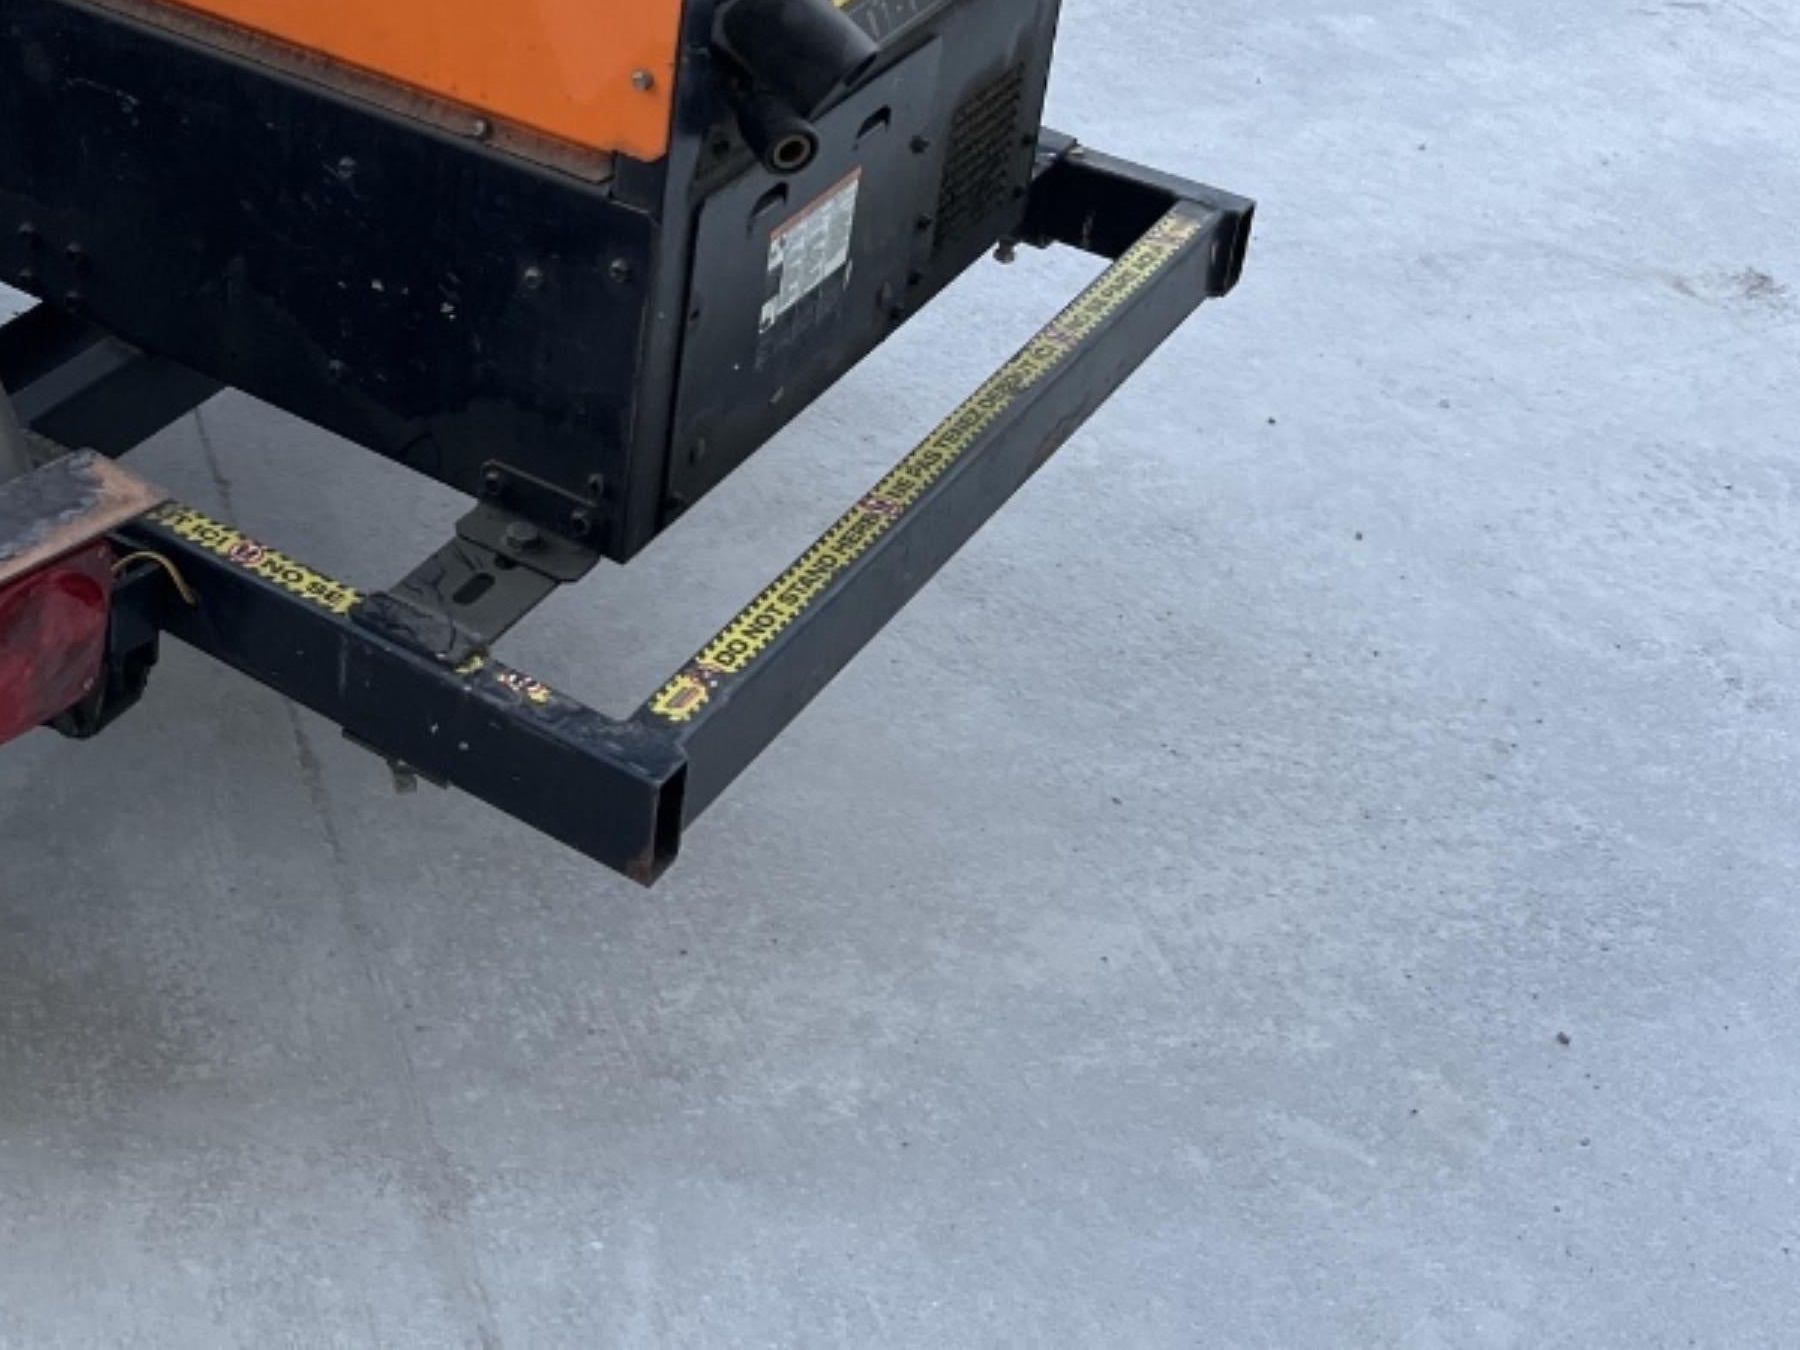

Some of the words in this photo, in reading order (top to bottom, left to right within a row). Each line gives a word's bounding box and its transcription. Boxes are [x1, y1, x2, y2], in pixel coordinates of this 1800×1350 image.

[262, 558, 304, 584] NO
[715, 639, 749, 667] DO
[741, 602, 785, 640] NOT
[778, 554, 839, 607] STAND
